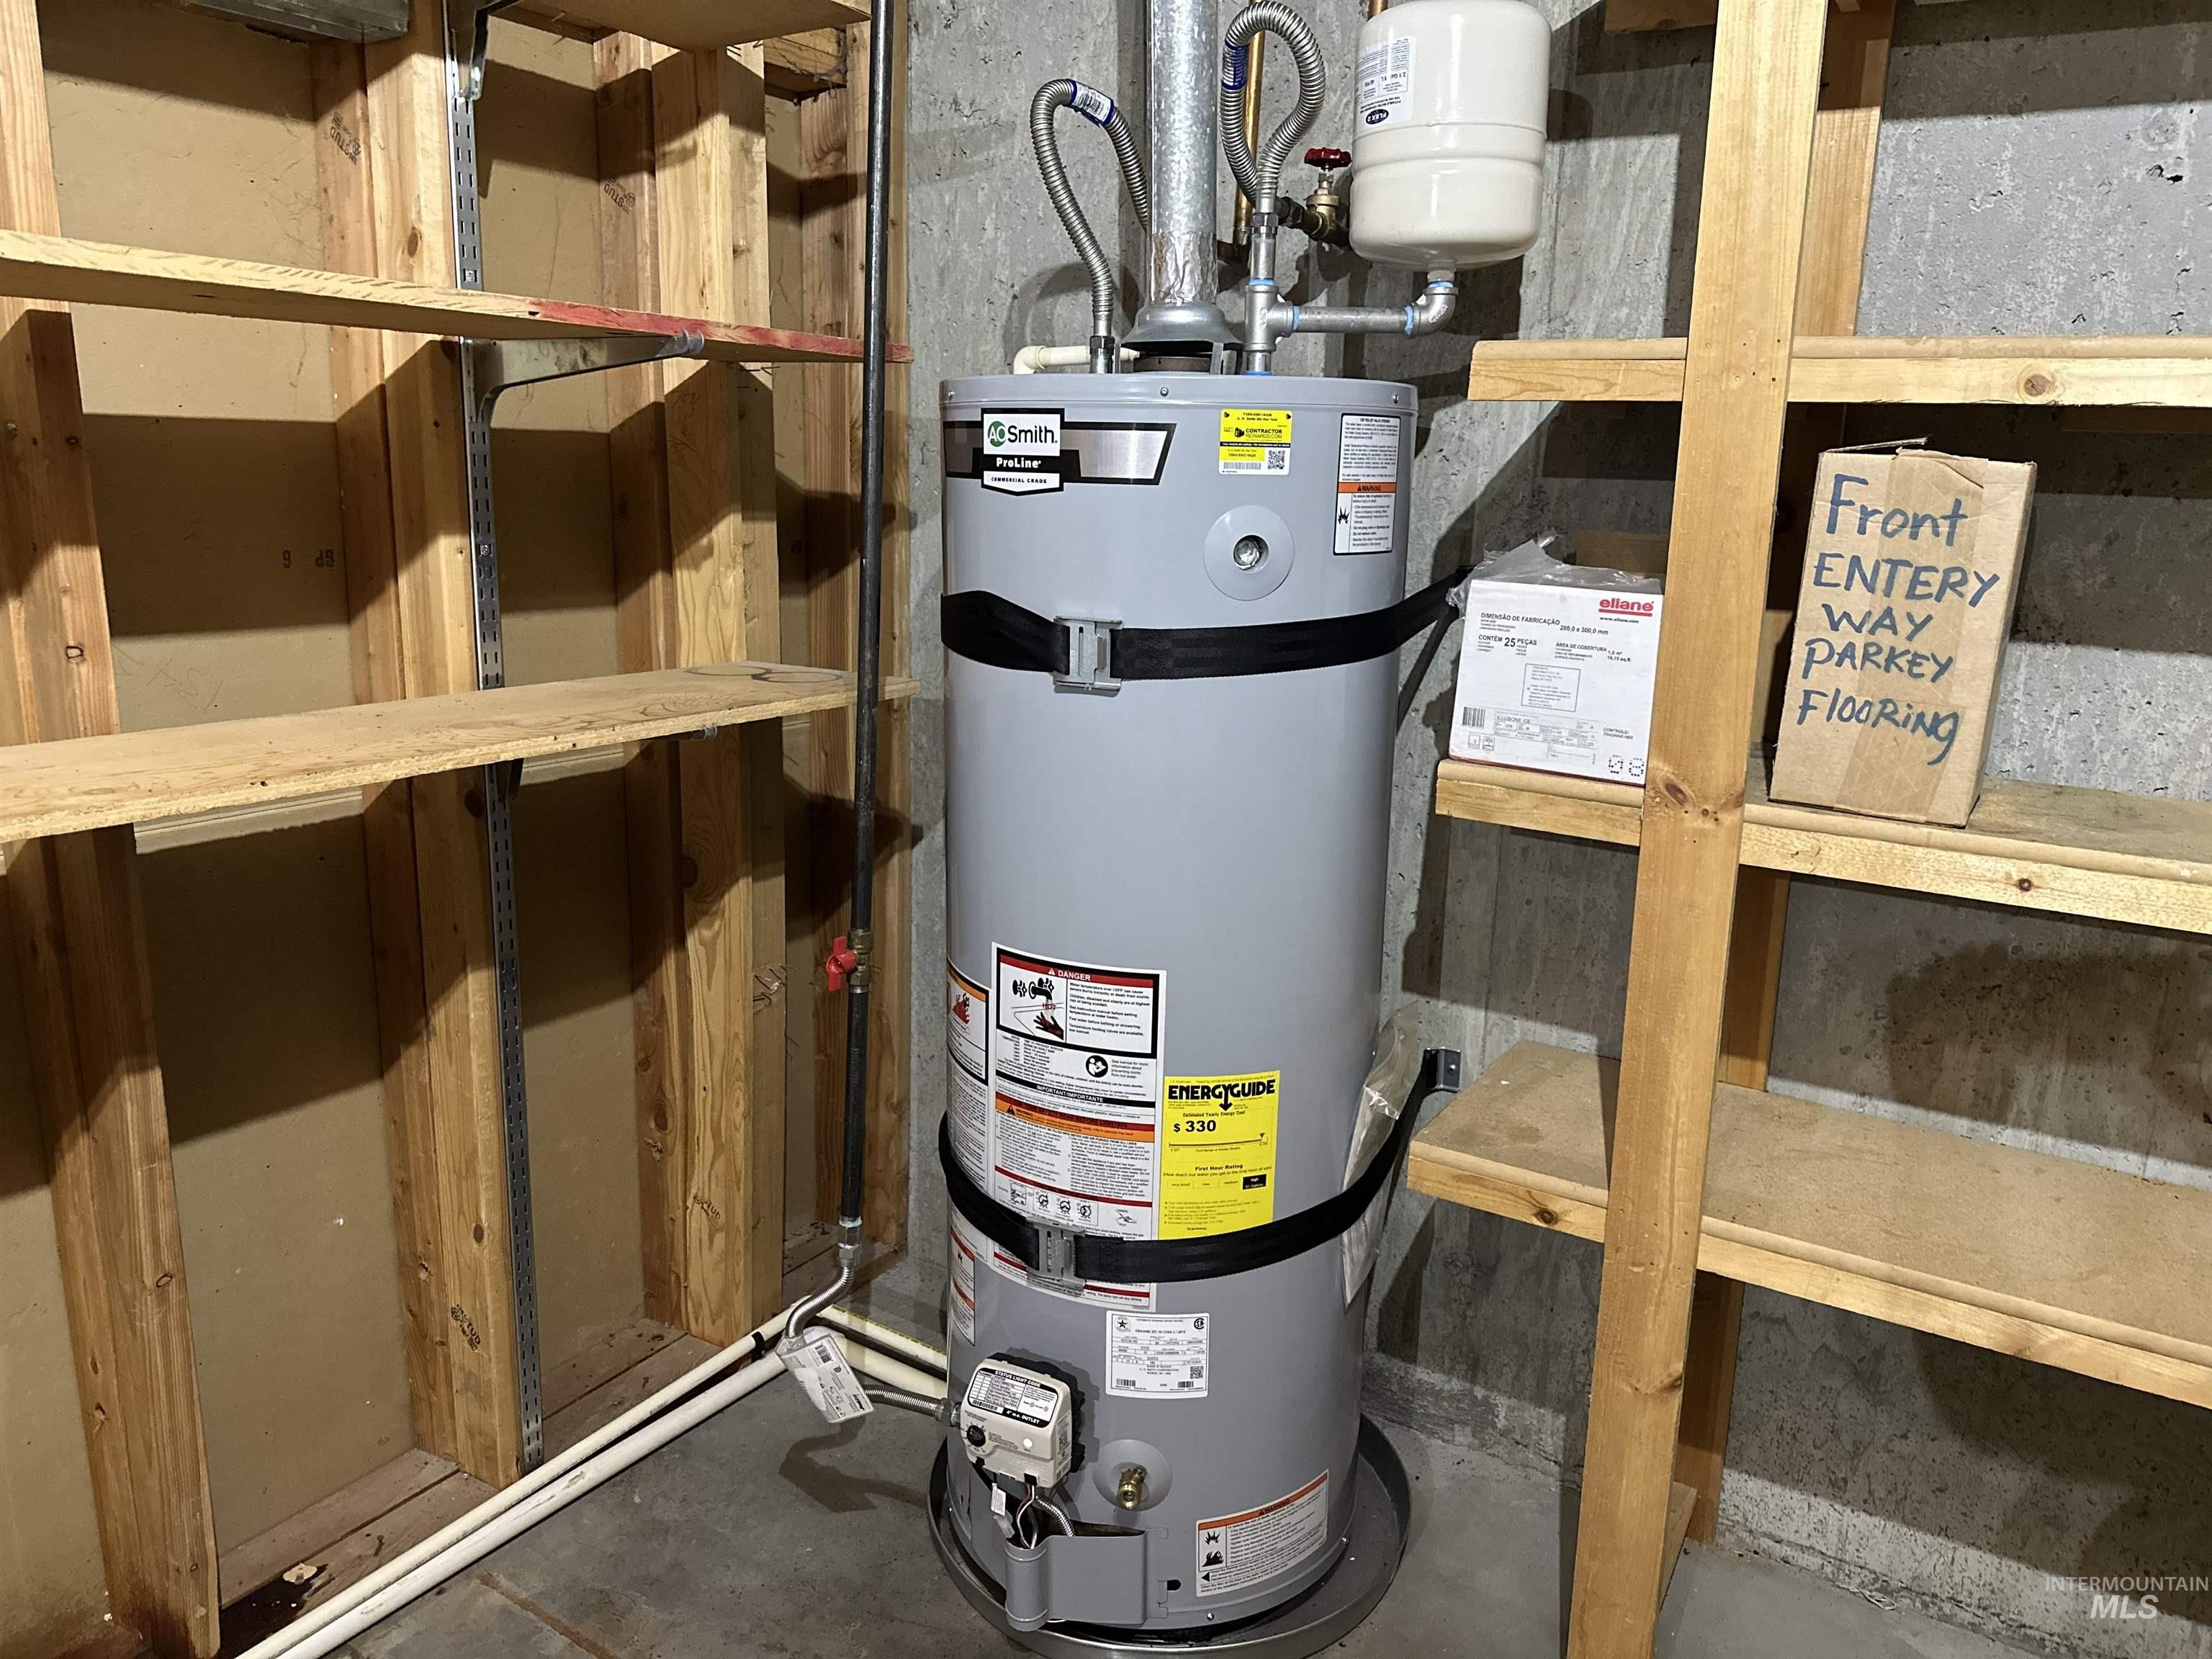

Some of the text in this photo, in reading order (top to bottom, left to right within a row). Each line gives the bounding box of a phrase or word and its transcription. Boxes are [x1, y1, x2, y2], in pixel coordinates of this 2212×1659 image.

[331, 127, 349, 156] STUD
[604, 184, 624, 207] STUD
[996, 457, 1038, 468] ProLine
[1826, 473, 1968, 547] Front
[1814, 552, 2000, 607] ENTERY
[1521, 616, 1560, 625] FABRICAÇÃO
[1821, 603, 1933, 642] WAY
[1504, 637, 1516, 647] 25
[1802, 638, 1954, 683] PARKEY
[1058, 969, 1091, 981] DANGER
[1037, 1085, 1103, 1102] IMPORTANT/IMPORTANTE
[1169, 1079, 1276, 1100] ENERGYGUIDE
[1174, 1120, 1216, 1133] $ 330
[995, 1370, 1012, 1379] STATUS
[1022, 1414, 1040, 1424] OUTLET
